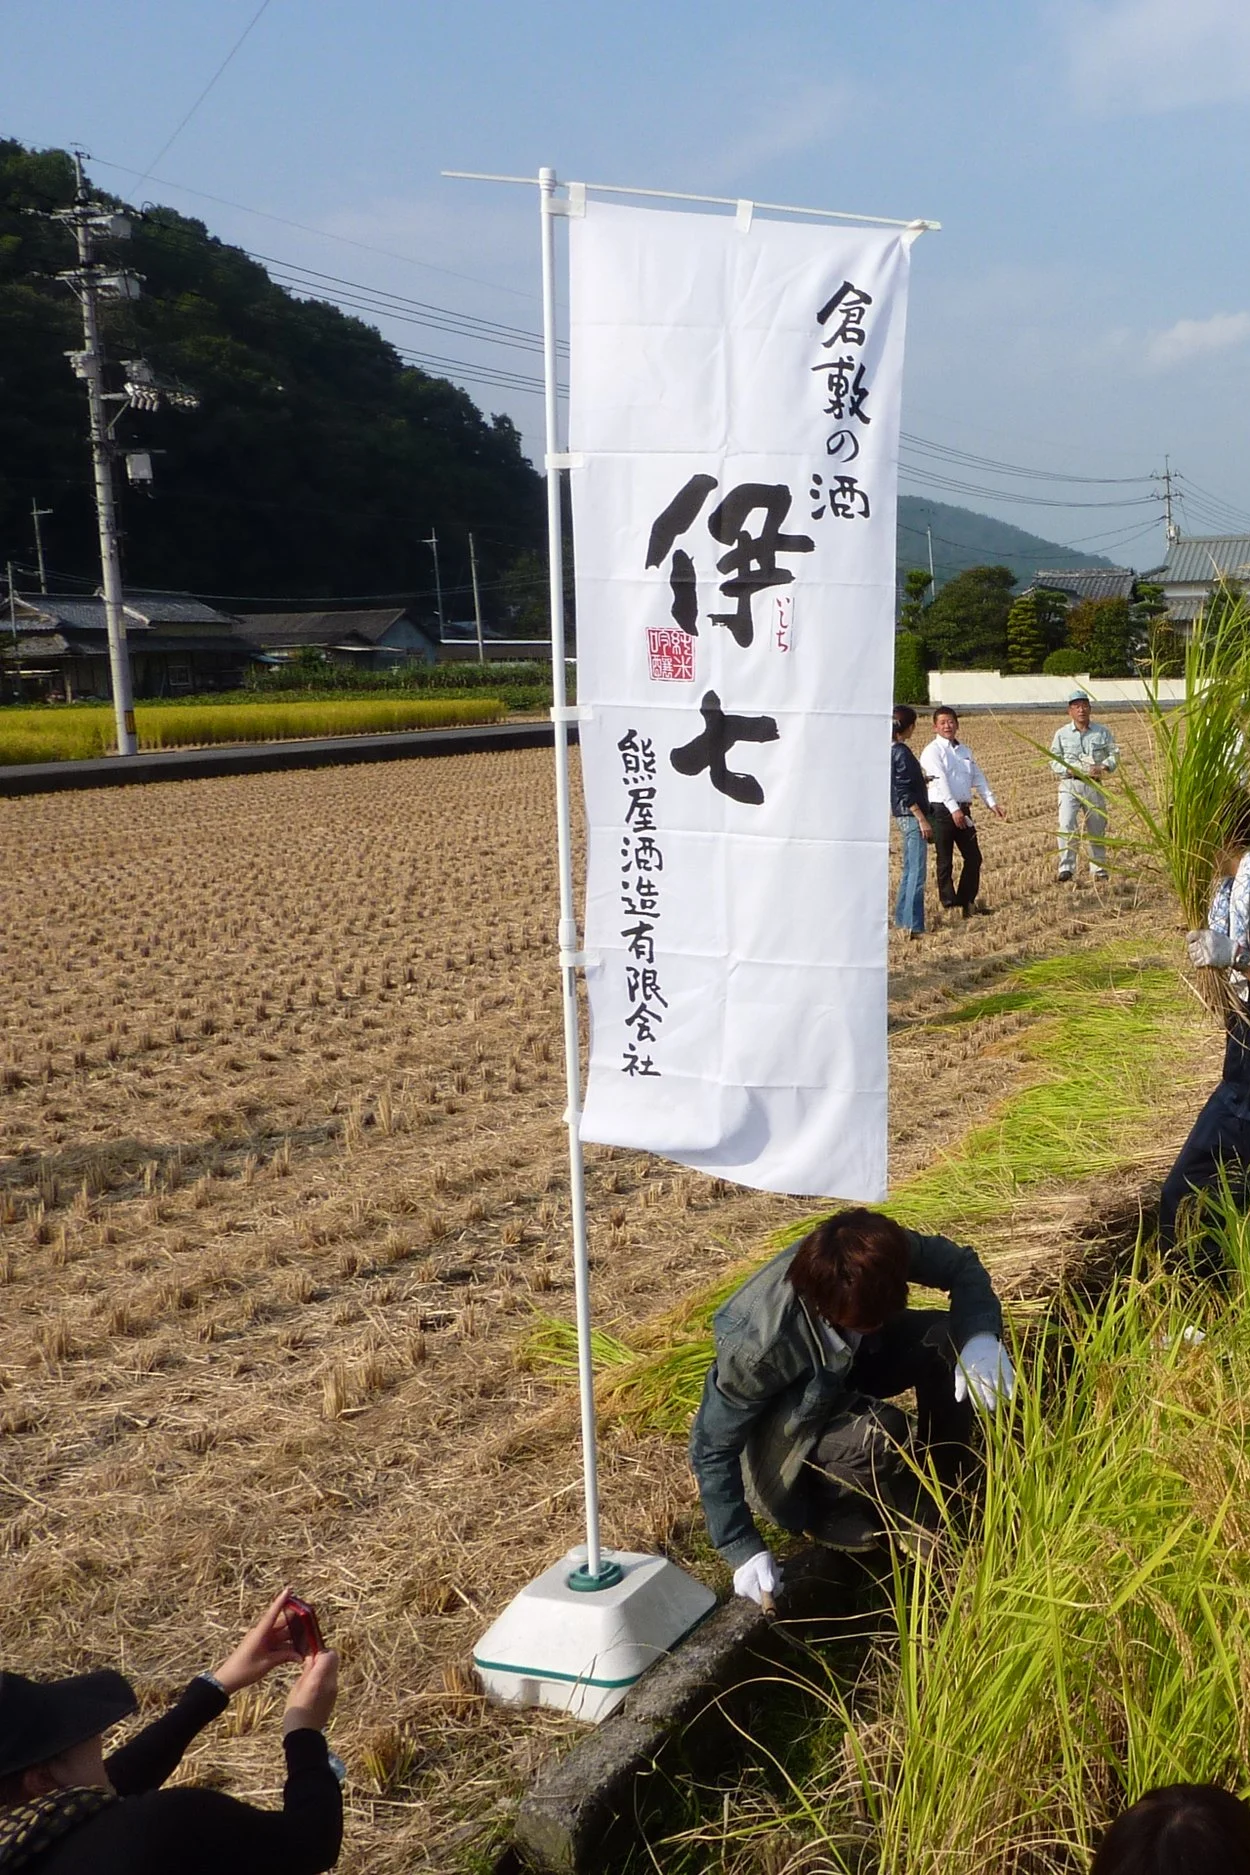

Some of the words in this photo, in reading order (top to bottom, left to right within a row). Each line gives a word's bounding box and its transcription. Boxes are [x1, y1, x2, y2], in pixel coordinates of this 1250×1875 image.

[809, 280, 873, 520] 倉敷の酒
[645, 474, 815, 804] 伊七
[775, 597, 792, 653] いしち
[617, 728, 668, 1077] 熊屋酒造有限会社
